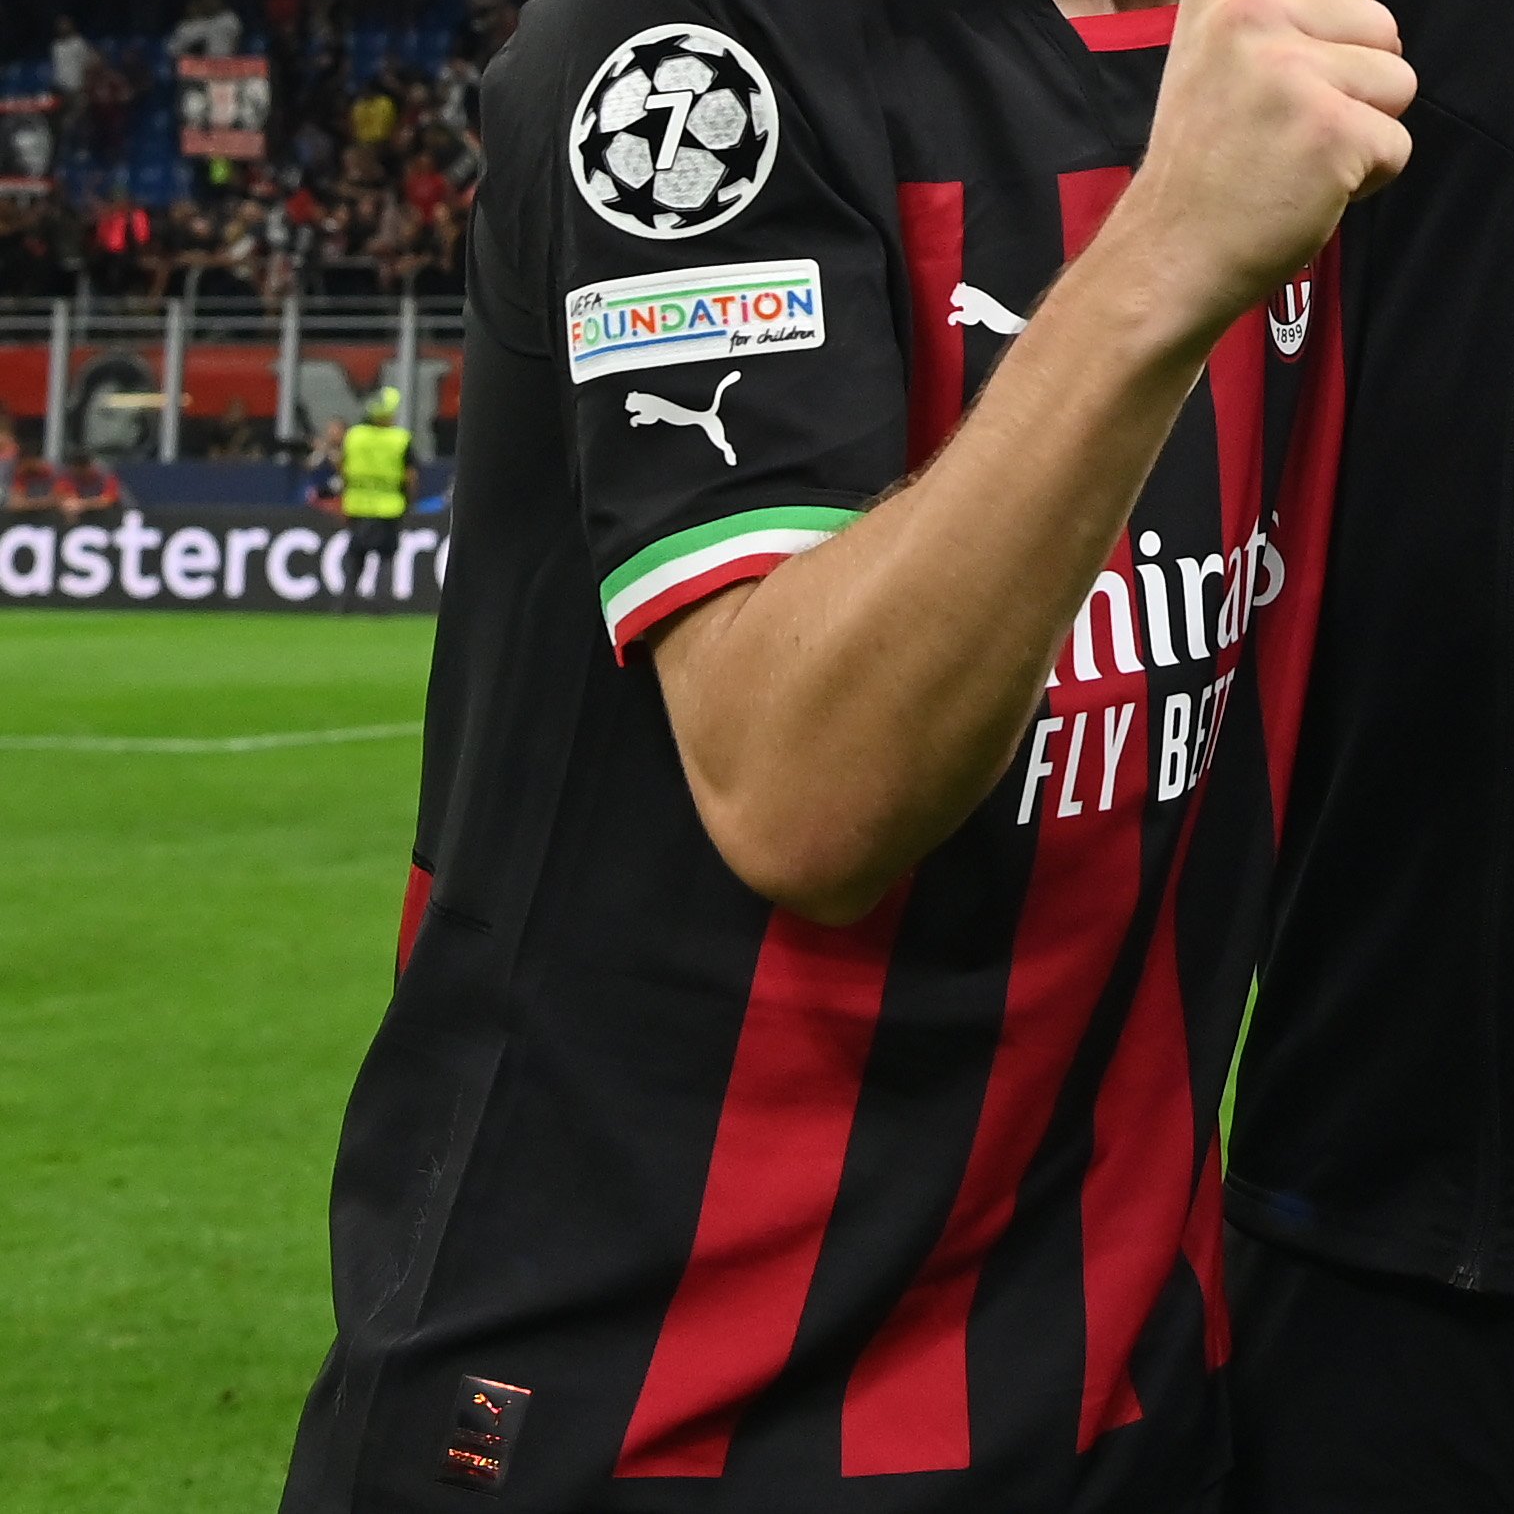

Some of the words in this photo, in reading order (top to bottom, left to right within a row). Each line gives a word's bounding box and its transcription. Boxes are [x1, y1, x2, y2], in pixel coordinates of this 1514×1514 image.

[644, 90, 694, 171] 7
[570, 292, 604, 319] UEFA
[571, 288, 814, 352] FOUNDATION
[728, 330, 752, 354] for
[756, 325, 816, 345] children
[1276, 324, 1303, 344] 1899
[1016, 701, 1136, 826] FLY
